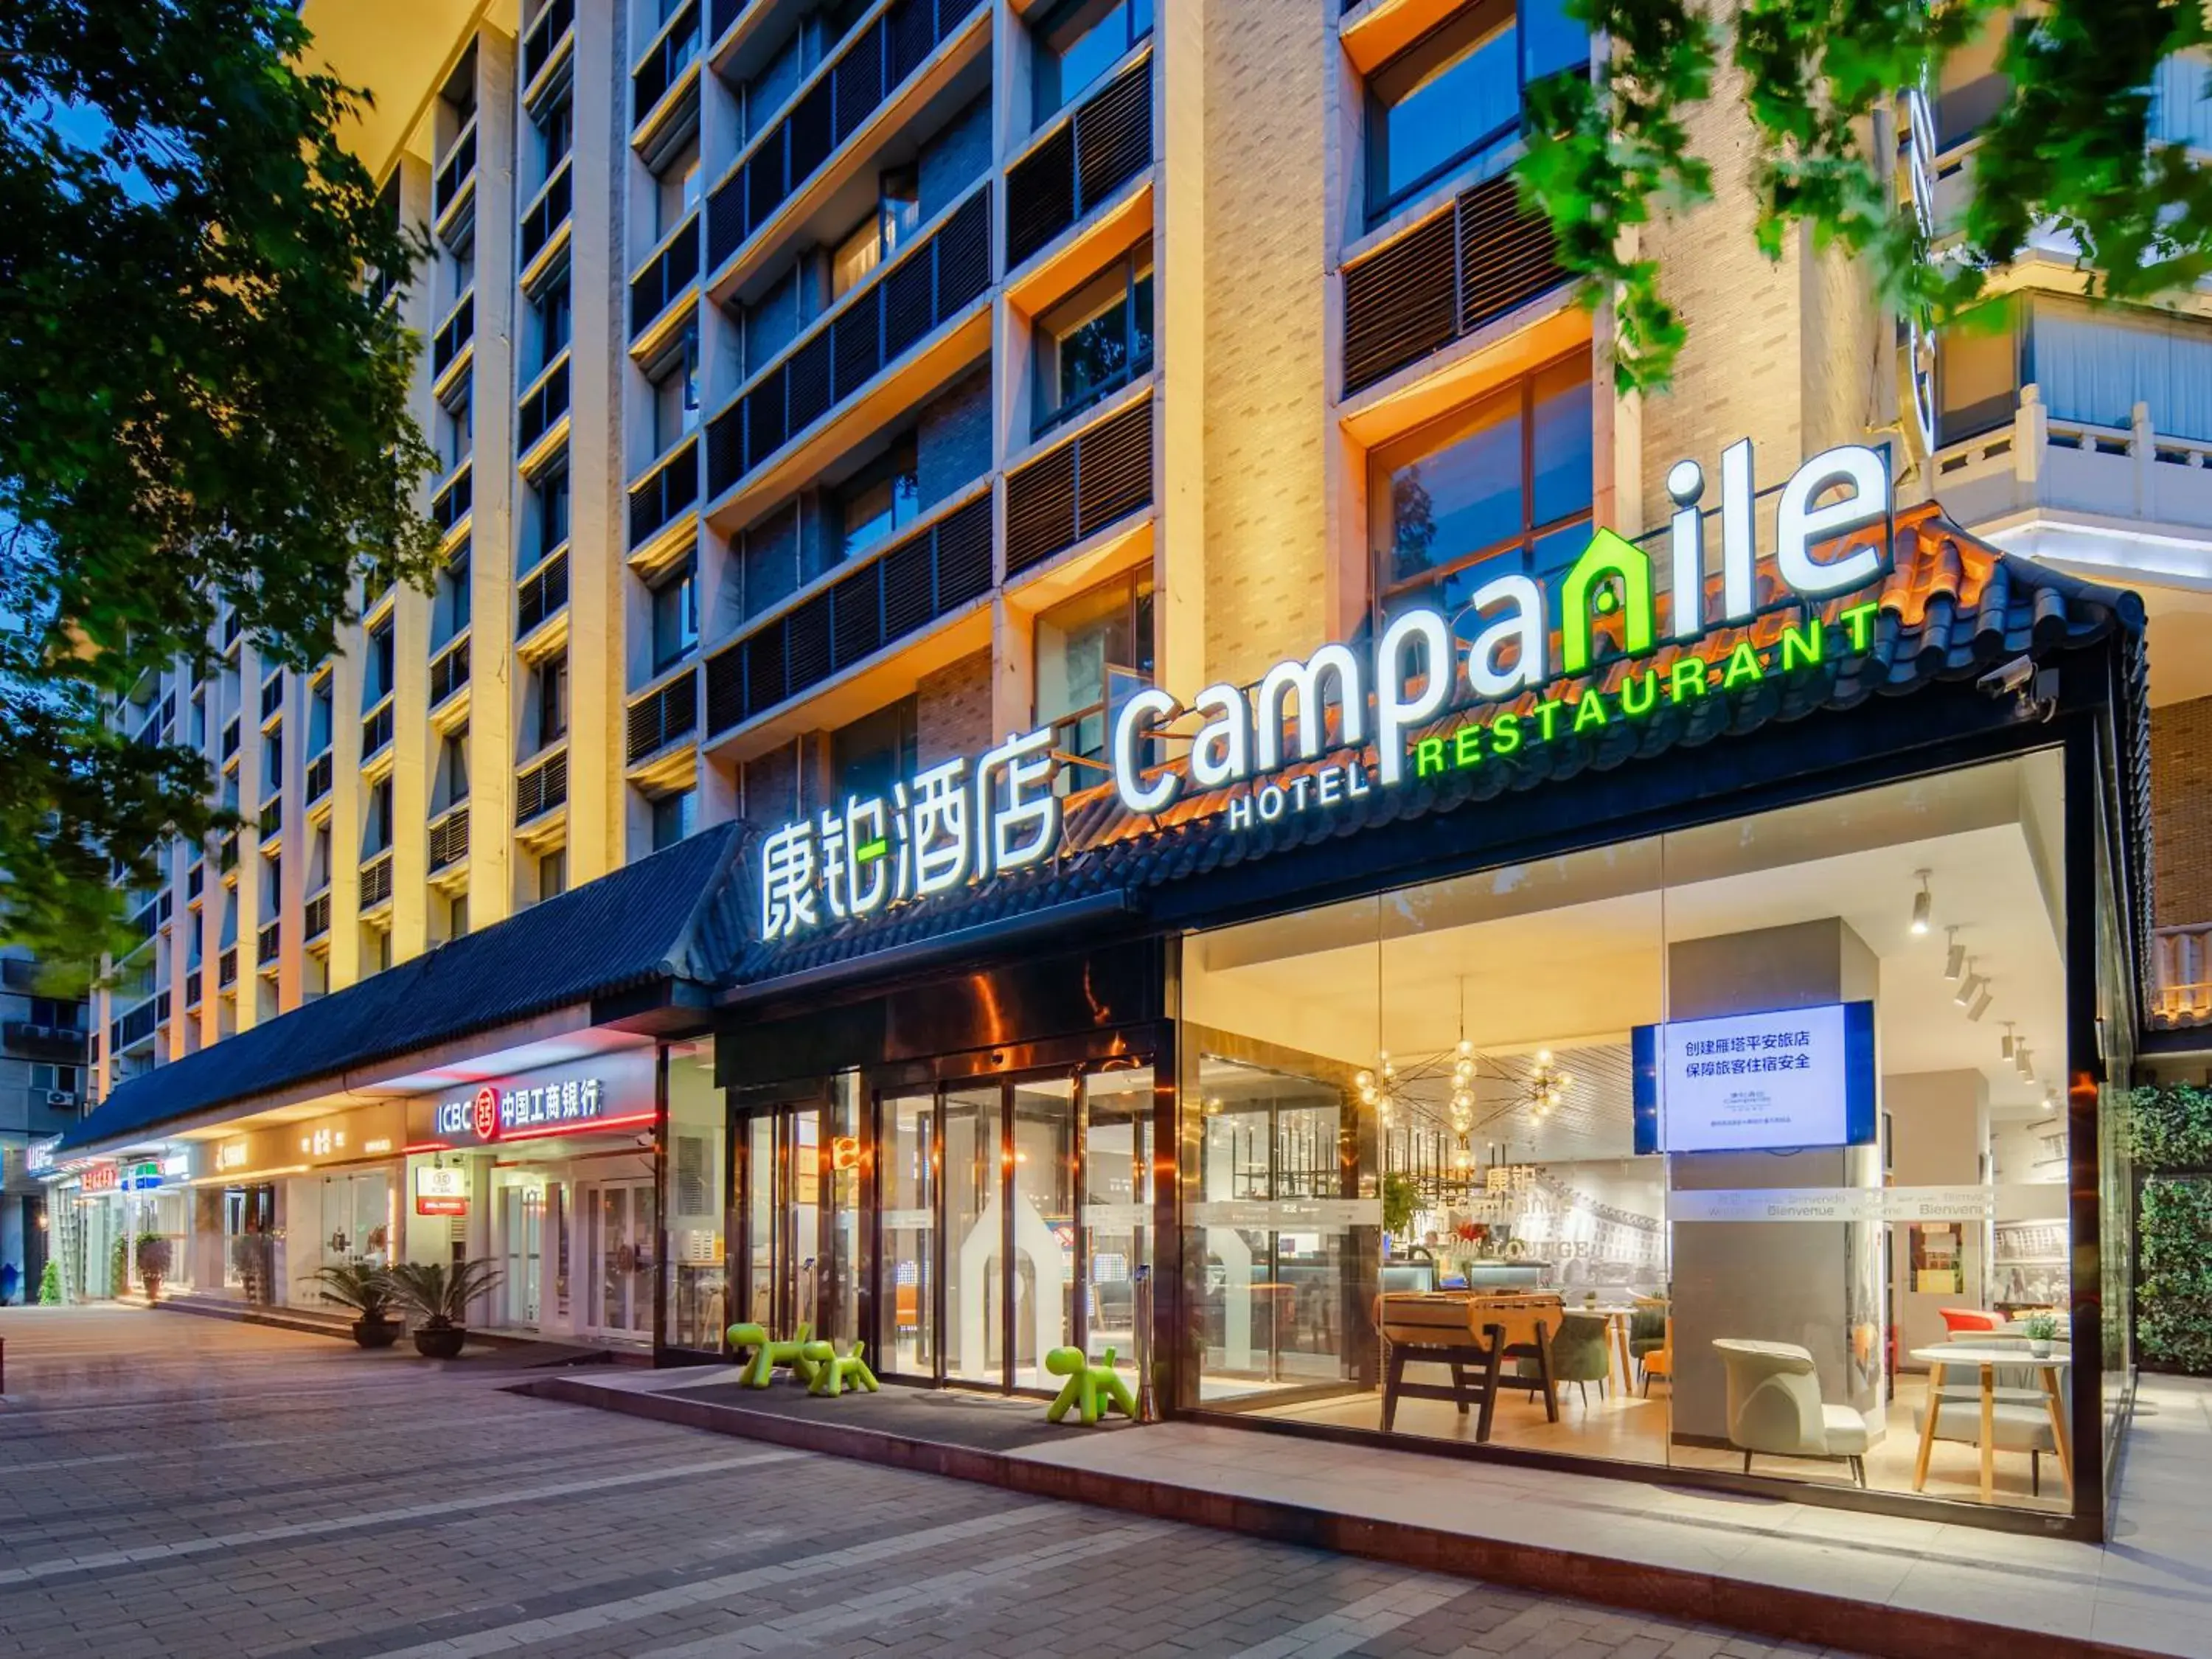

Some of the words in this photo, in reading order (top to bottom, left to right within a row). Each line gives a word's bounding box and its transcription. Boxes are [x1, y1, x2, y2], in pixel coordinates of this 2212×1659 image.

[1114, 437, 1891, 814] Campanile
[1228, 767, 1371, 832] HOTEL
[1416, 601, 1880, 778] RESTAURANT
[762, 726, 1055, 942] 康铂酒店
[1686, 1031, 1810, 1057] 创建雁塔平安旅店
[1686, 1053, 1810, 1078] 保障旅客住宿安全
[437, 1100, 473, 1133] ICBC
[501, 1079, 602, 1127] 中国工商银行
[1767, 1205, 1835, 1217] Bienvenue
